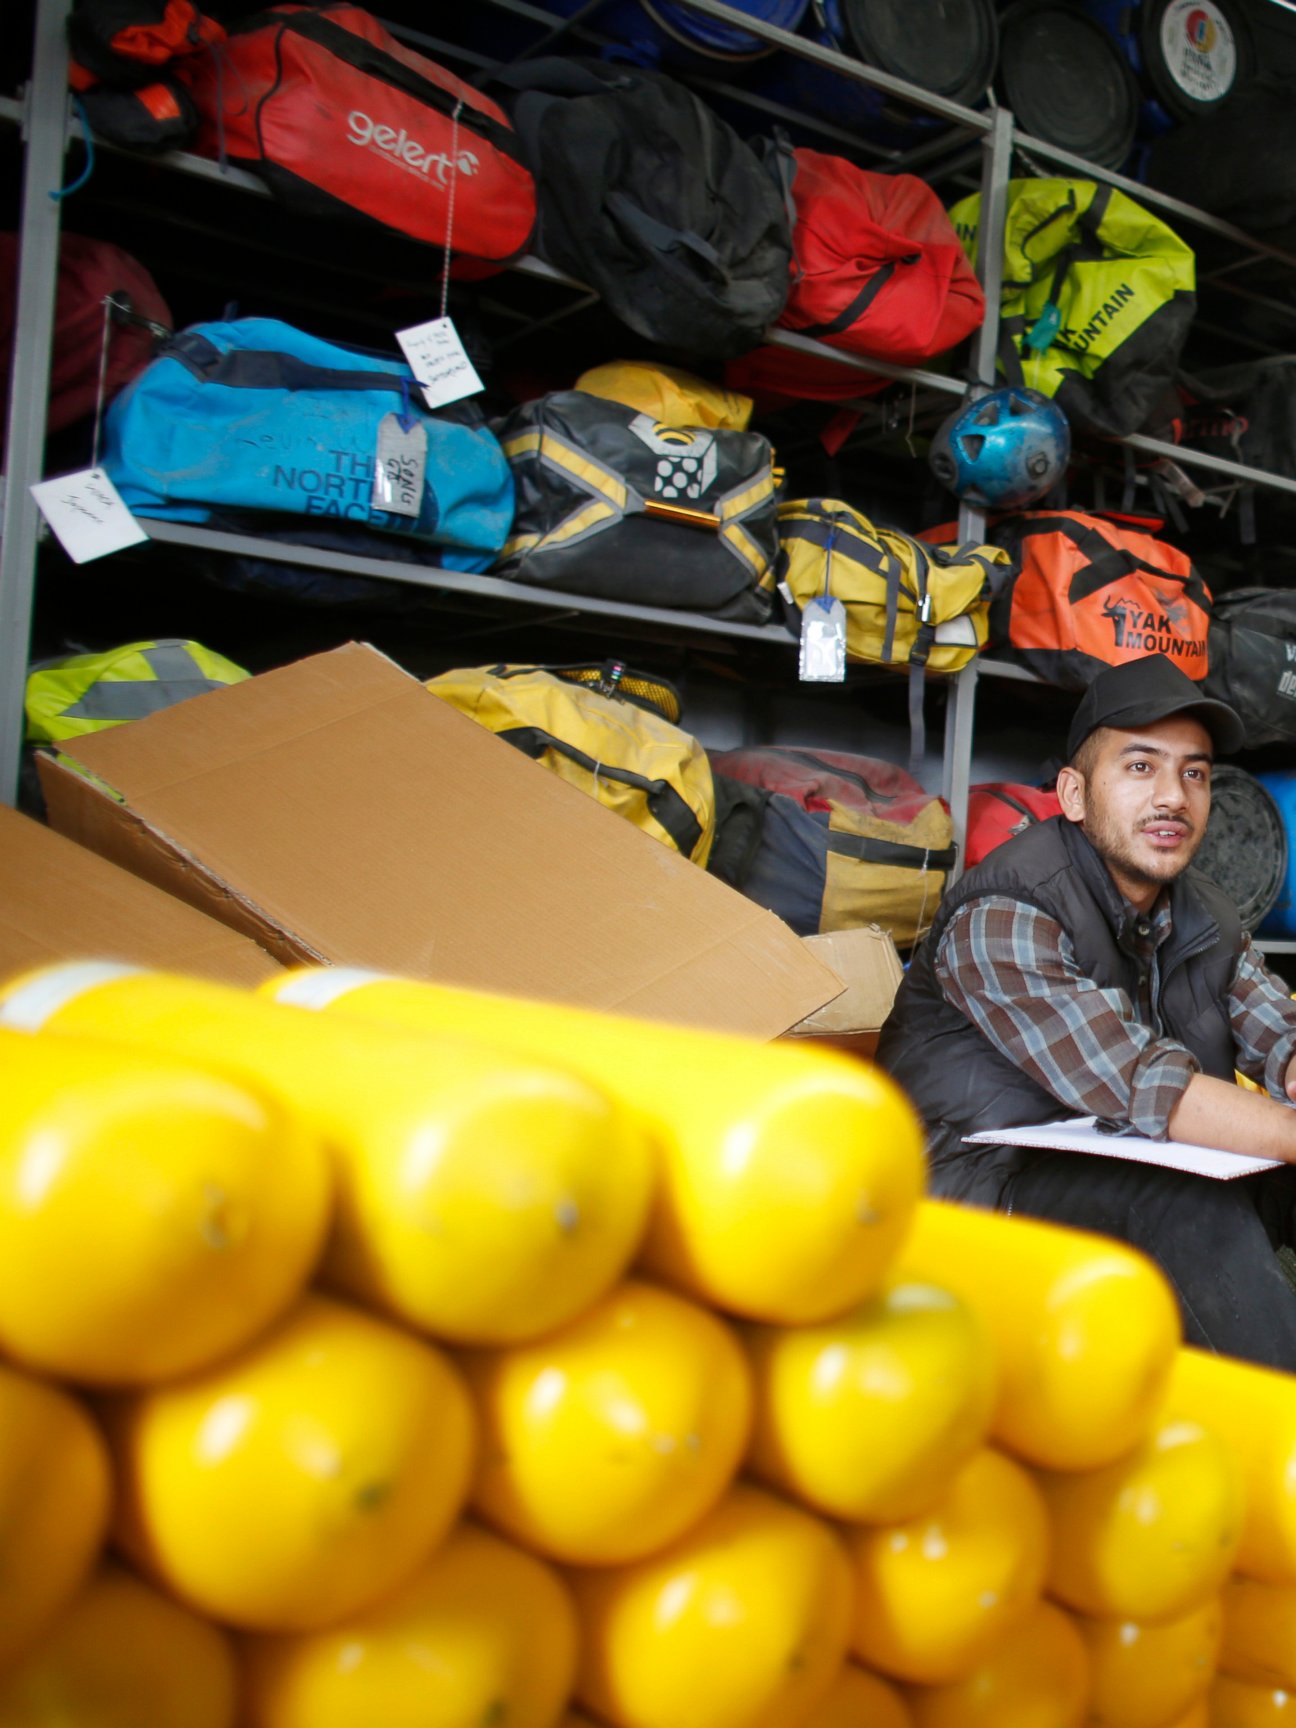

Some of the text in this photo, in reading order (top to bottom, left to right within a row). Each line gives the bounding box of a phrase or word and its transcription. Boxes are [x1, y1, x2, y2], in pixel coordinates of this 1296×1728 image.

[348, 110, 453, 185] gelert
[328, 450, 376, 479] TH
[273, 464, 377, 504] NORT
[1129, 610, 1172, 635] YAK
